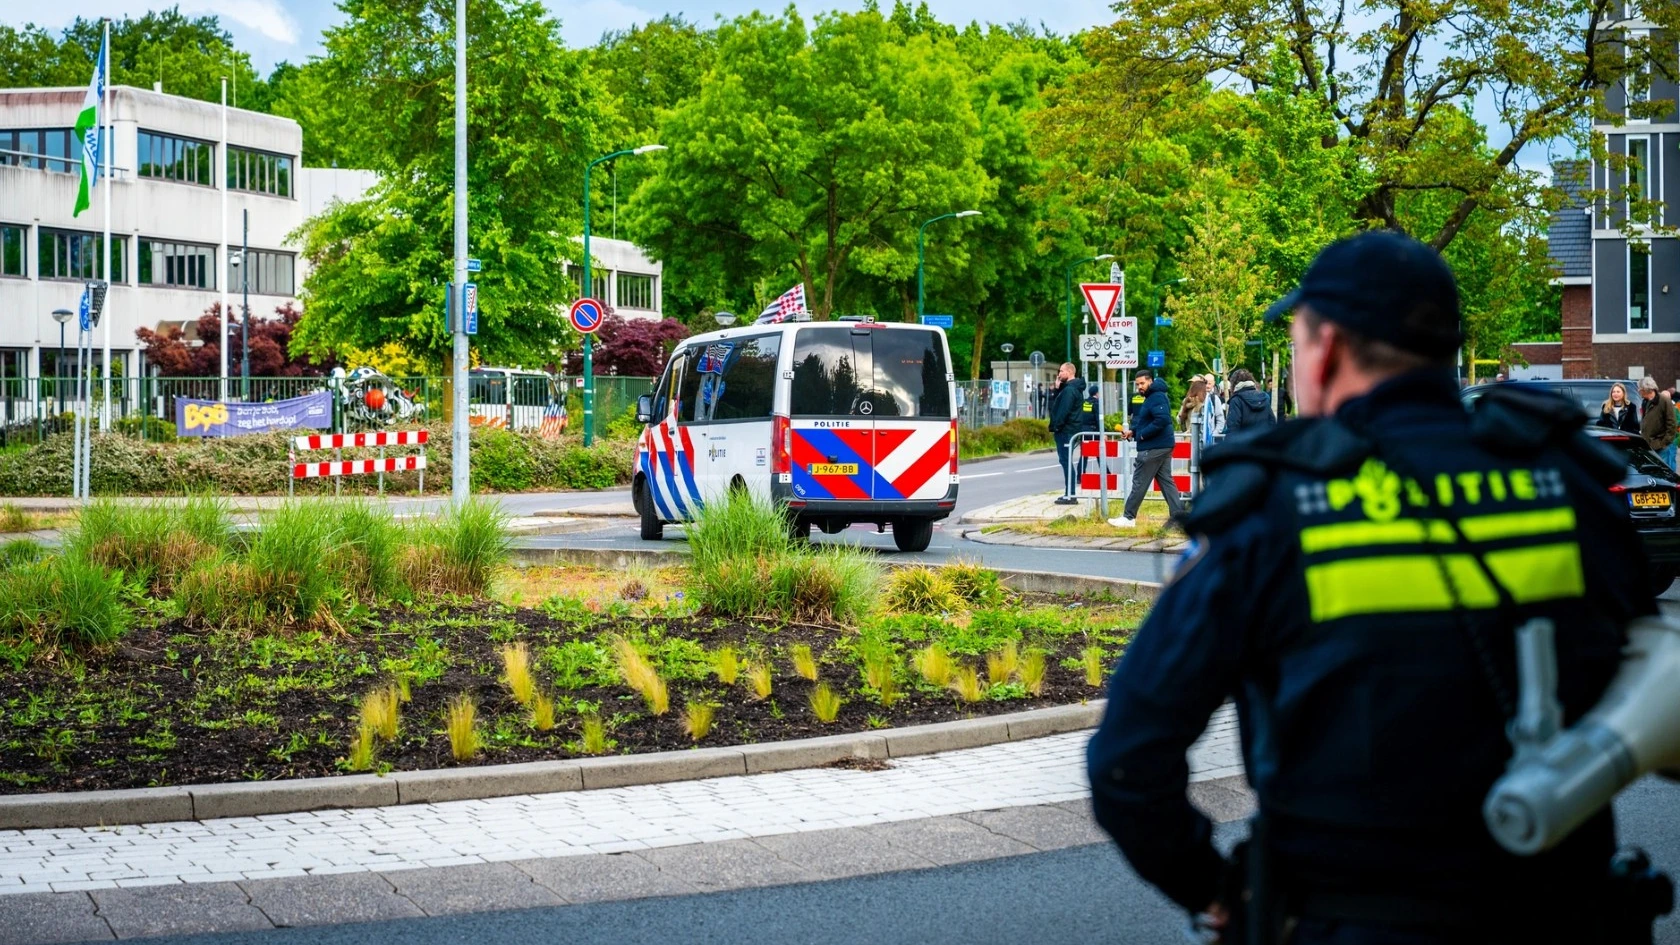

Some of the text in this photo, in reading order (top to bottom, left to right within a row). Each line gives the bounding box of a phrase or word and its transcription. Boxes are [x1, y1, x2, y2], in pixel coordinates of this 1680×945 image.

[184, 404, 229, 432] BOB
[237, 419, 252, 429] zeg
[252, 417, 266, 427] het
[814, 465, 854, 474] J-967-BB
[1634, 493, 1667, 505] GBF-52-P
